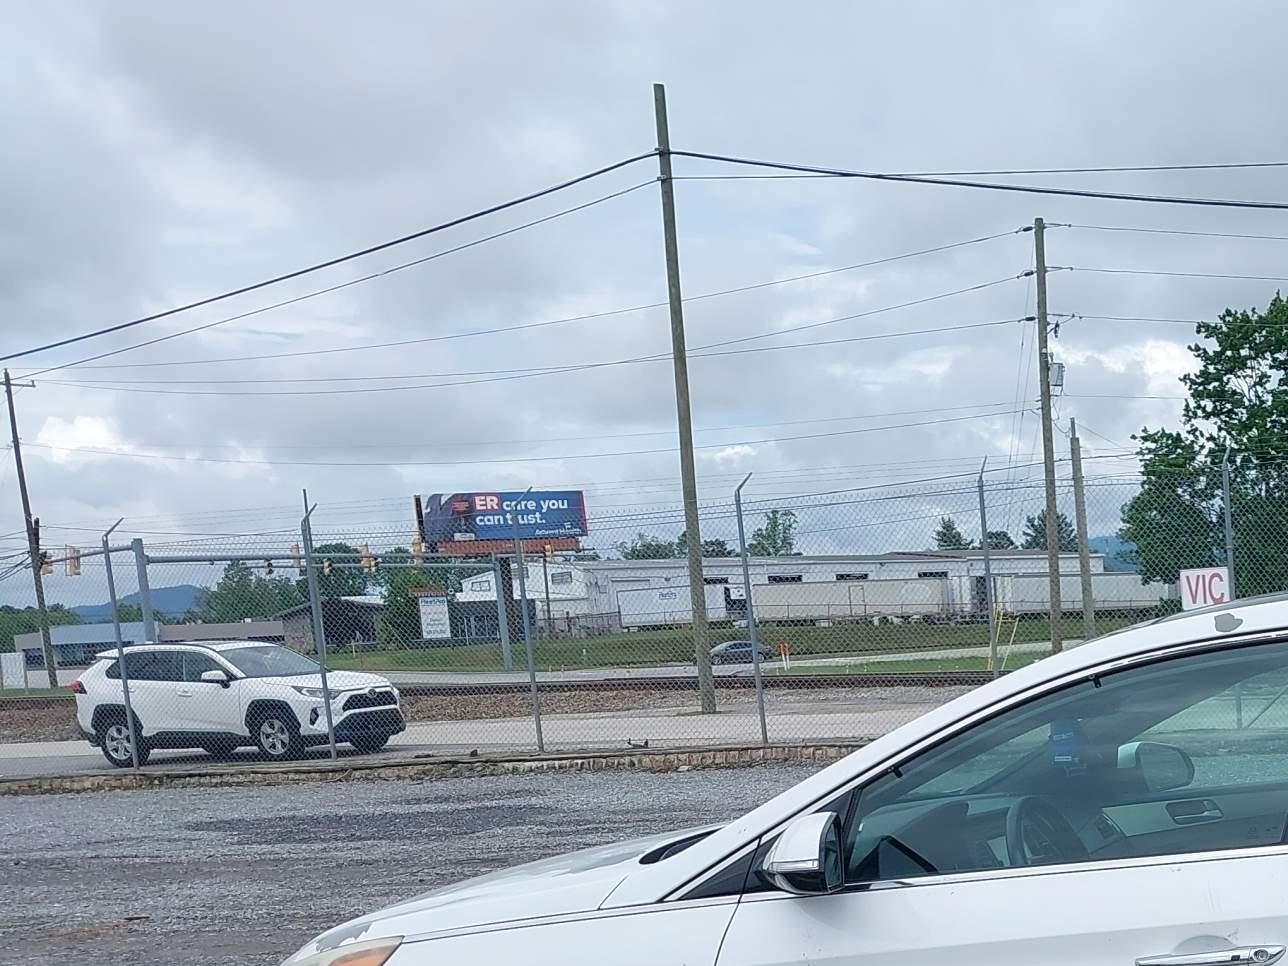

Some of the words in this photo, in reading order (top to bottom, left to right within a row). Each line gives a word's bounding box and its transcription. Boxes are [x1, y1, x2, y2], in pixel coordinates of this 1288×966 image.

[474, 496, 499, 510] ER
[541, 500, 568, 512] you
[476, 515, 504, 525] can
[1186, 573, 1225, 604] VIC
